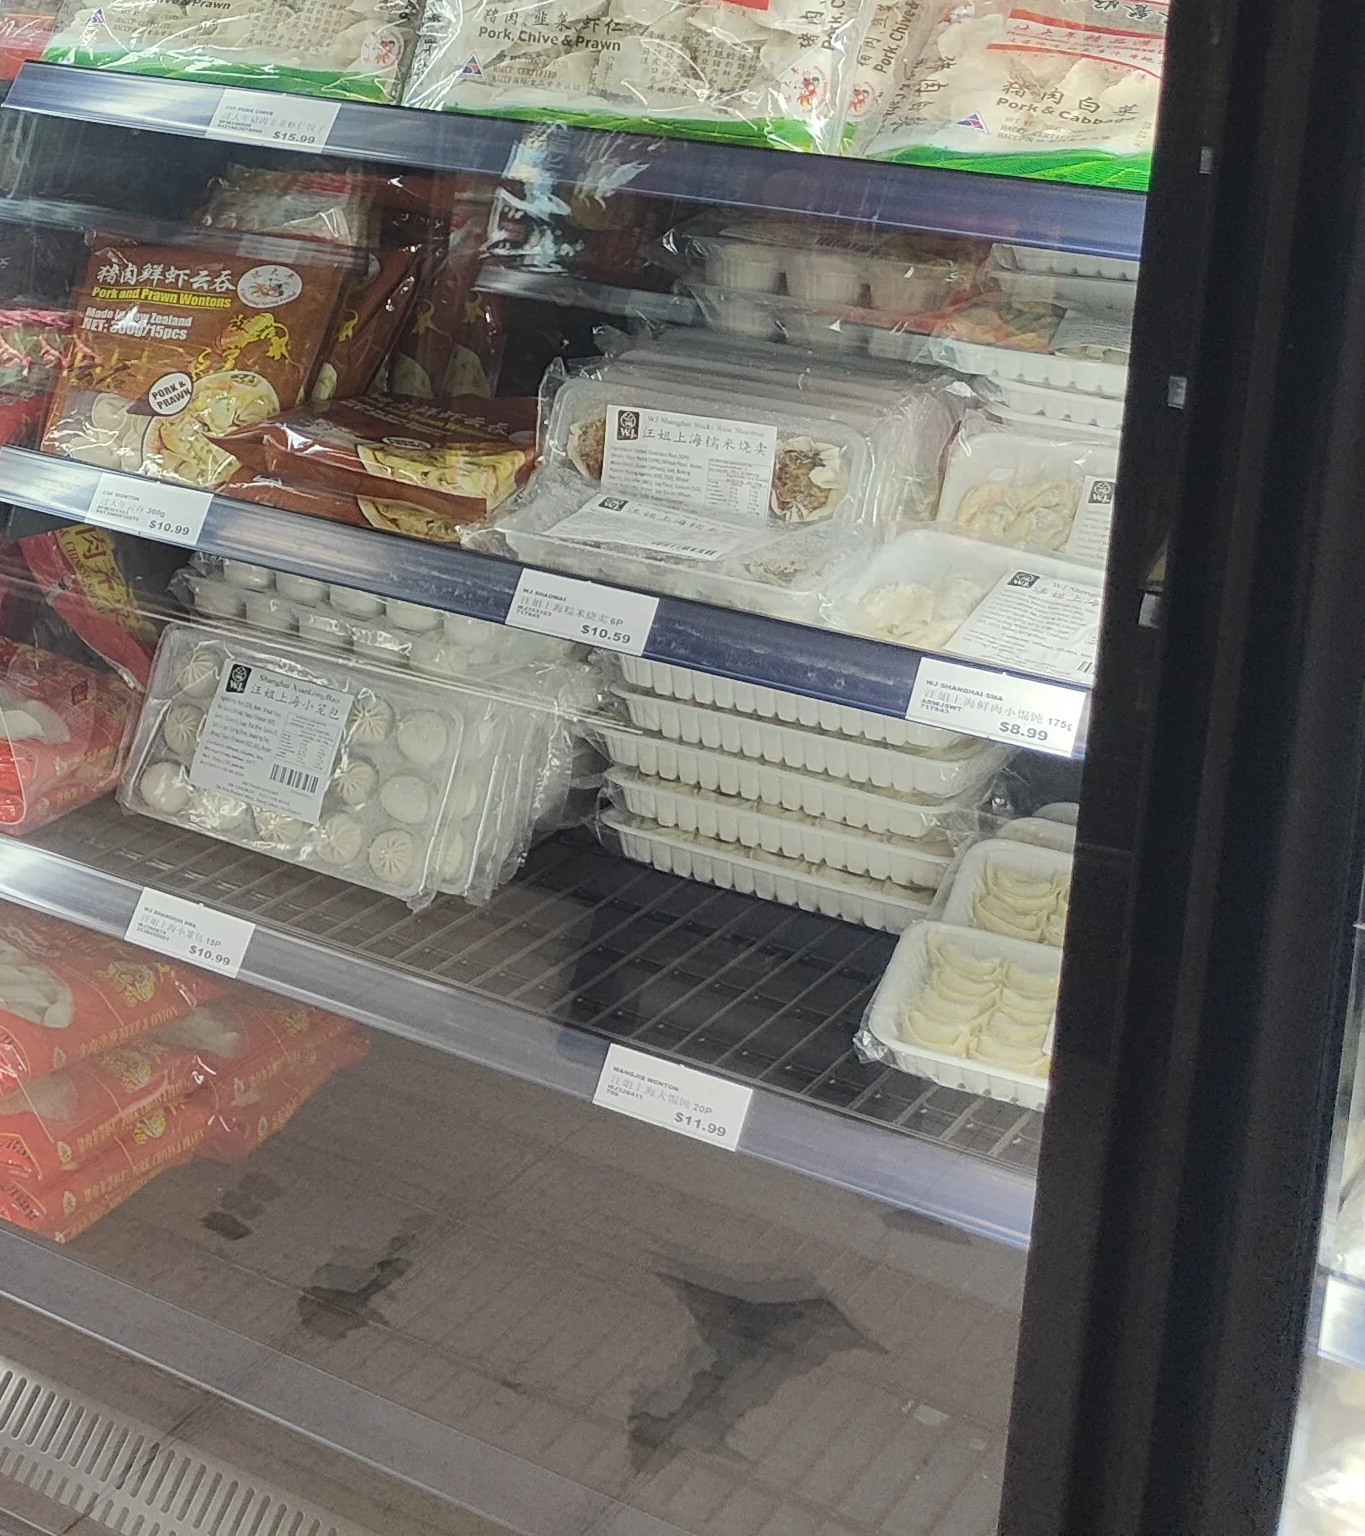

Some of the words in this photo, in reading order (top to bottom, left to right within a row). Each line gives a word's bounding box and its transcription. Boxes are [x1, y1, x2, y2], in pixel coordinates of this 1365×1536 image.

[482, 7, 624, 35] 猪肉、韭菜、虾仁
[890, 11, 916, 42] Chive
[477, 25, 516, 44] Pork,
[518, 29, 559, 46] Chive
[575, 36, 621, 52] Prawn
[996, 96, 1039, 115] Pork
[272, 130, 316, 145] $15.99
[95, 262, 237, 293] 猪肉鲜虾云吞
[91, 285, 118, 301] Pork
[117, 287, 140, 301] and
[140, 289, 178, 305] Prawn
[178, 291, 232, 309] Wontons
[81, 318, 110, 334] NET:
[85, 306, 114, 321] Made
[149, 312, 193, 328] Zealand
[150, 382, 179, 401] PORK
[156, 386, 193, 412] PRAWN
[642, 428, 769, 457] 汪姐上海糯米烧卖
[146, 507, 166, 518] 300g
[148, 519, 190, 537] $10.99
[609, 616, 624, 627] 6P
[580, 623, 632, 645] $10.59
[250, 682, 341, 722] 汪姐上海小笼包
[939, 682, 985, 699] SHANGHAI
[985, 693, 1004, 703] SMA
[998, 721, 1049, 742] $8.99
[205, 937, 221, 947] 15P
[188, 944, 231, 967] $10.99
[612, 1066, 646, 1082] WANGJIE
[647, 1076, 679, 1093] WONTON
[692, 1103, 713, 1115] 20P
[673, 1112, 727, 1137] $11.99
